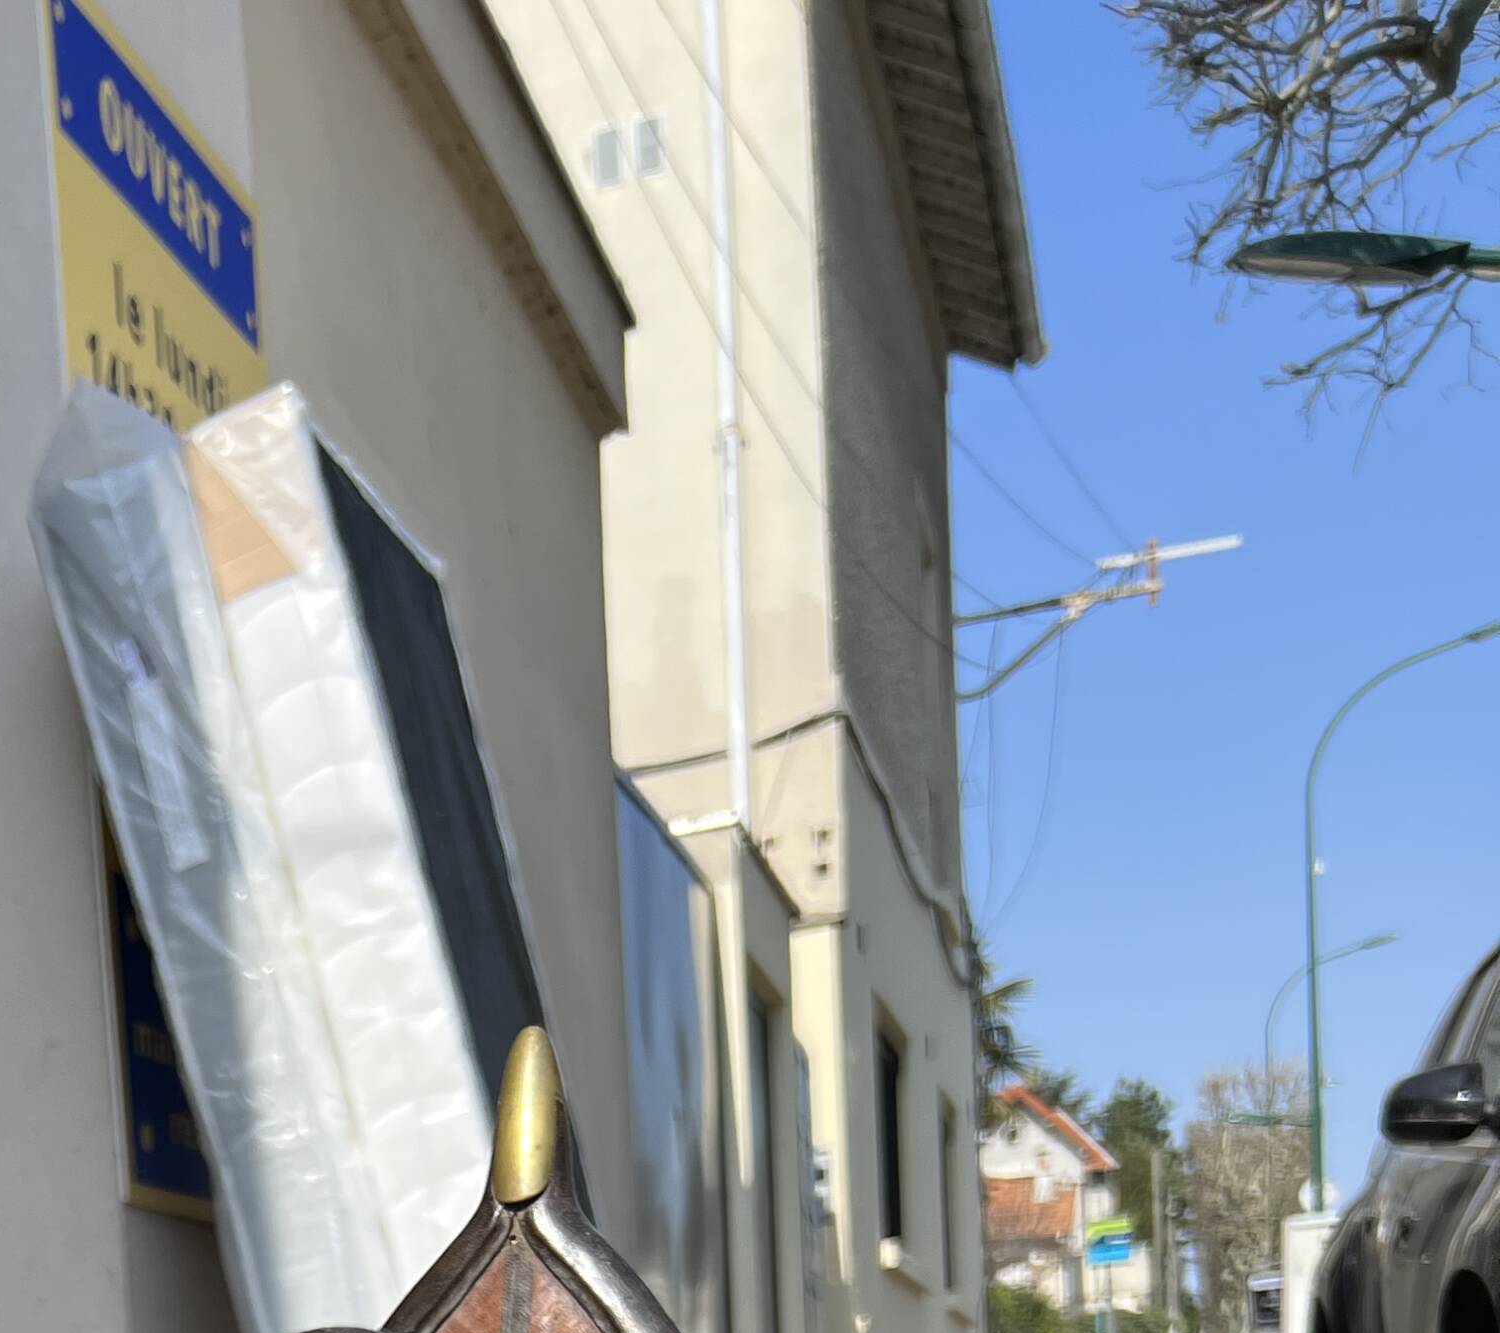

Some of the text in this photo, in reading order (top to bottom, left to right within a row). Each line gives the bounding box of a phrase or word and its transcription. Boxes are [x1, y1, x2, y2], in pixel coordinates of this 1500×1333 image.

[98, 74, 223, 270] OUVERT
[112, 260, 231, 416] le lundi
